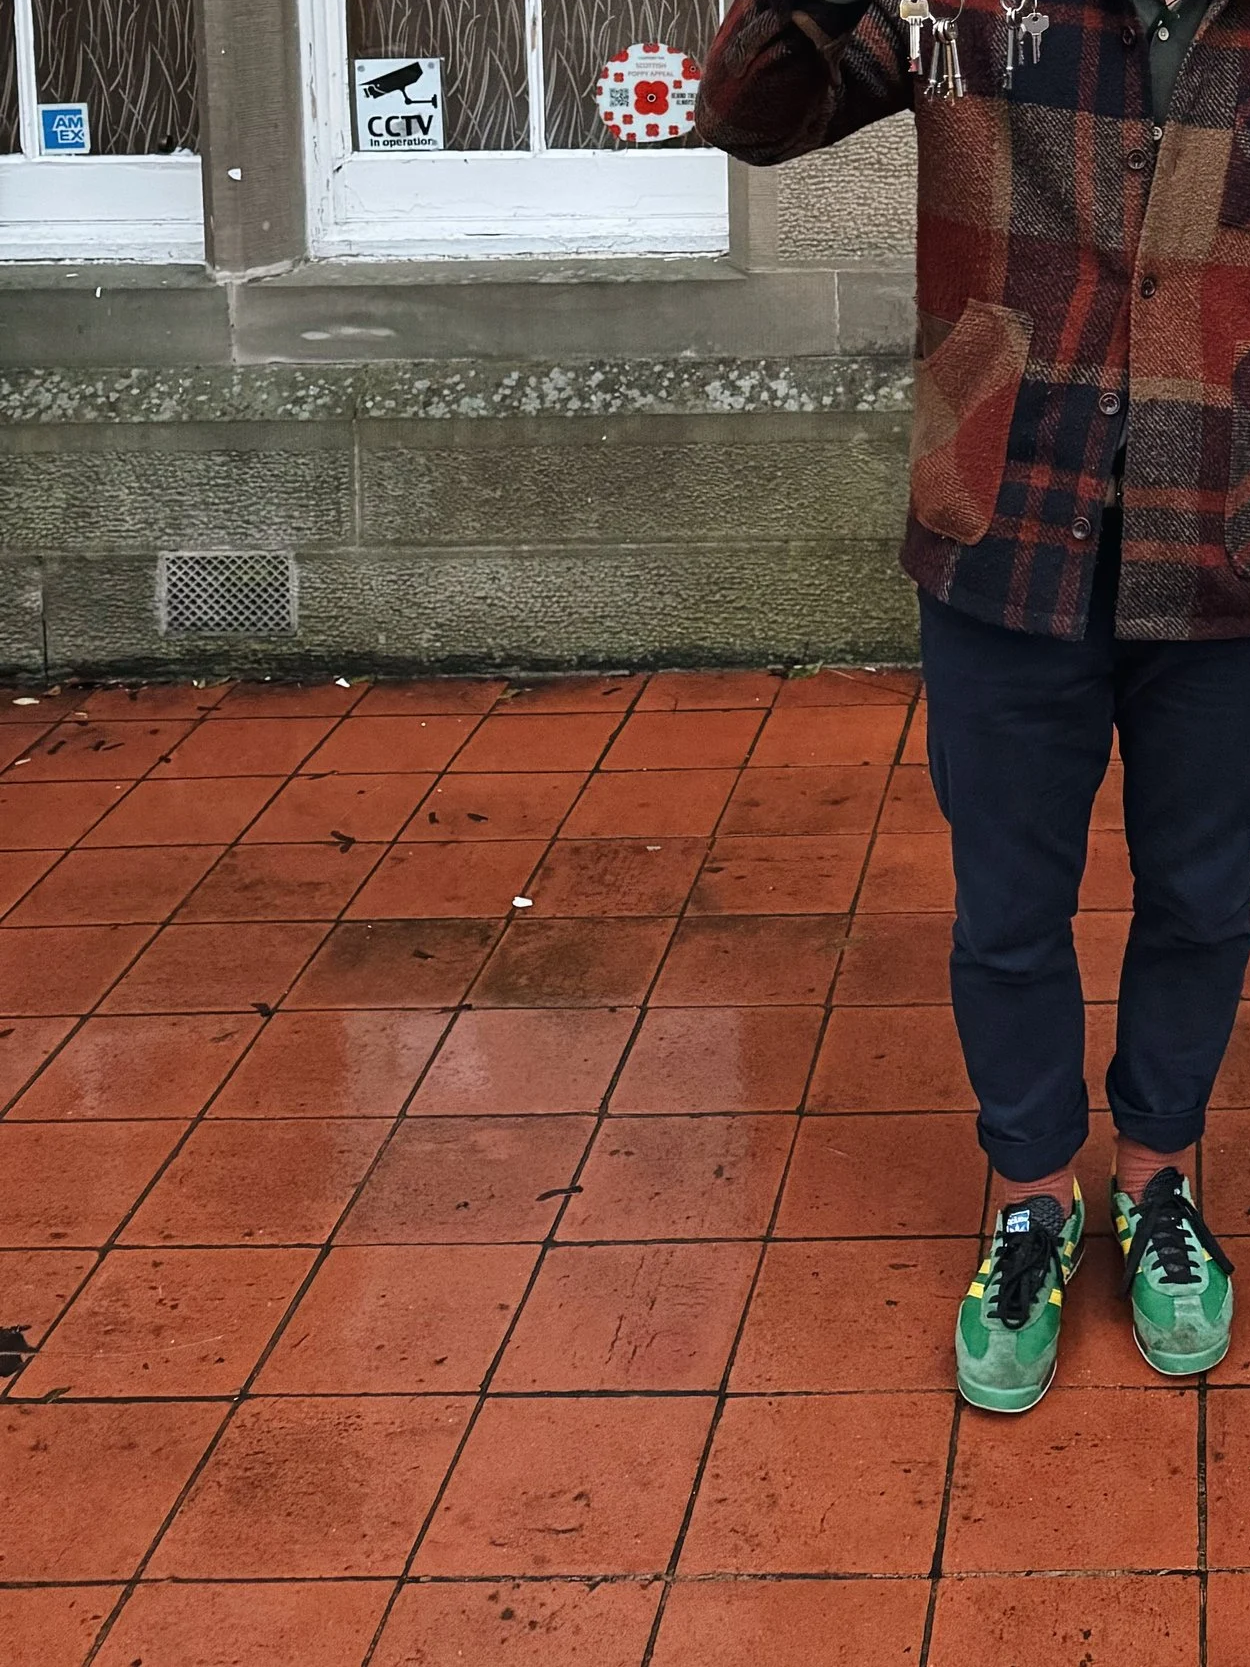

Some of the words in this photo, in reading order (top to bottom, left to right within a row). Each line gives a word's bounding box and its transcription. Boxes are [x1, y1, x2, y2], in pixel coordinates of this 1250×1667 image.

[52, 114, 84, 131] AM
[367, 114, 434, 138] CCTV
[57, 129, 85, 144] EX
[382, 137, 434, 148] operation
